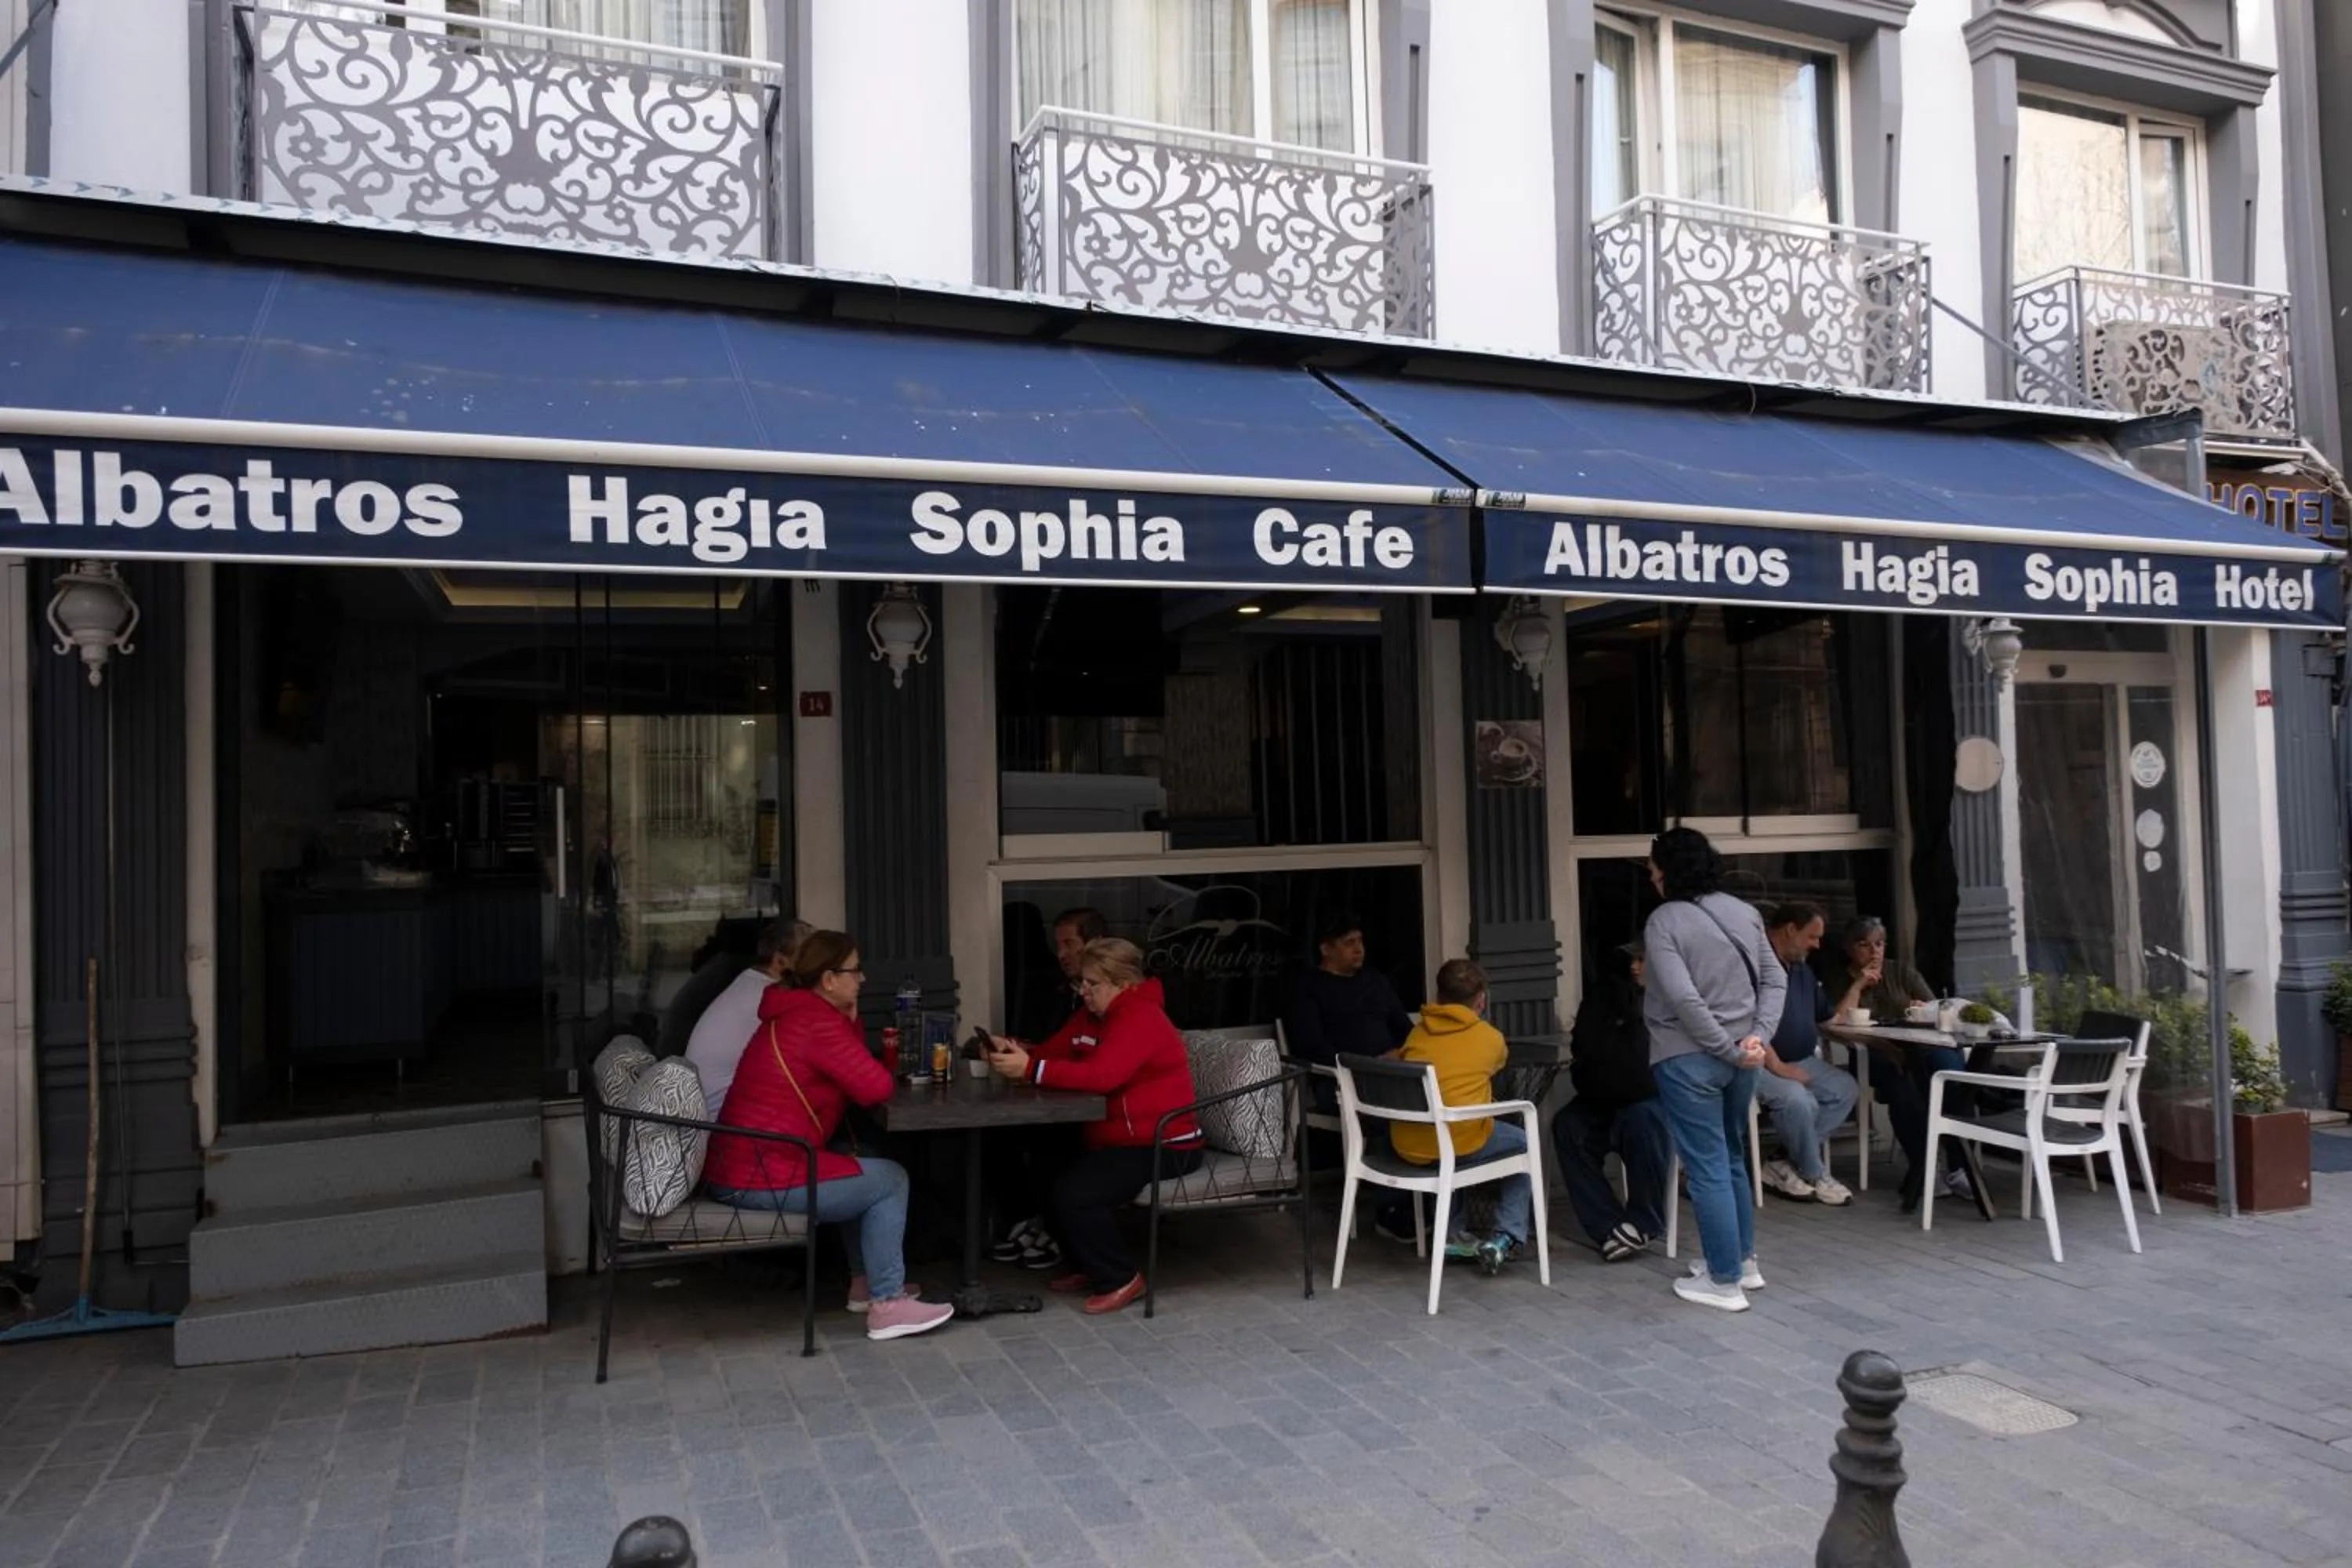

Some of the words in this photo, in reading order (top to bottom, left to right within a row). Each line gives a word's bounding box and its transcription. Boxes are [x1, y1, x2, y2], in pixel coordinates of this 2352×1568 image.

[0, 448, 463, 538] Albatros
[910, 491, 1185, 572] Sophia
[1254, 507, 1414, 569] Cafe
[1544, 521, 1791, 587] Albatros
[1842, 541, 1980, 605] Hagia
[2024, 553, 2179, 612] Sophia
[2215, 564, 2314, 611] Hotel
